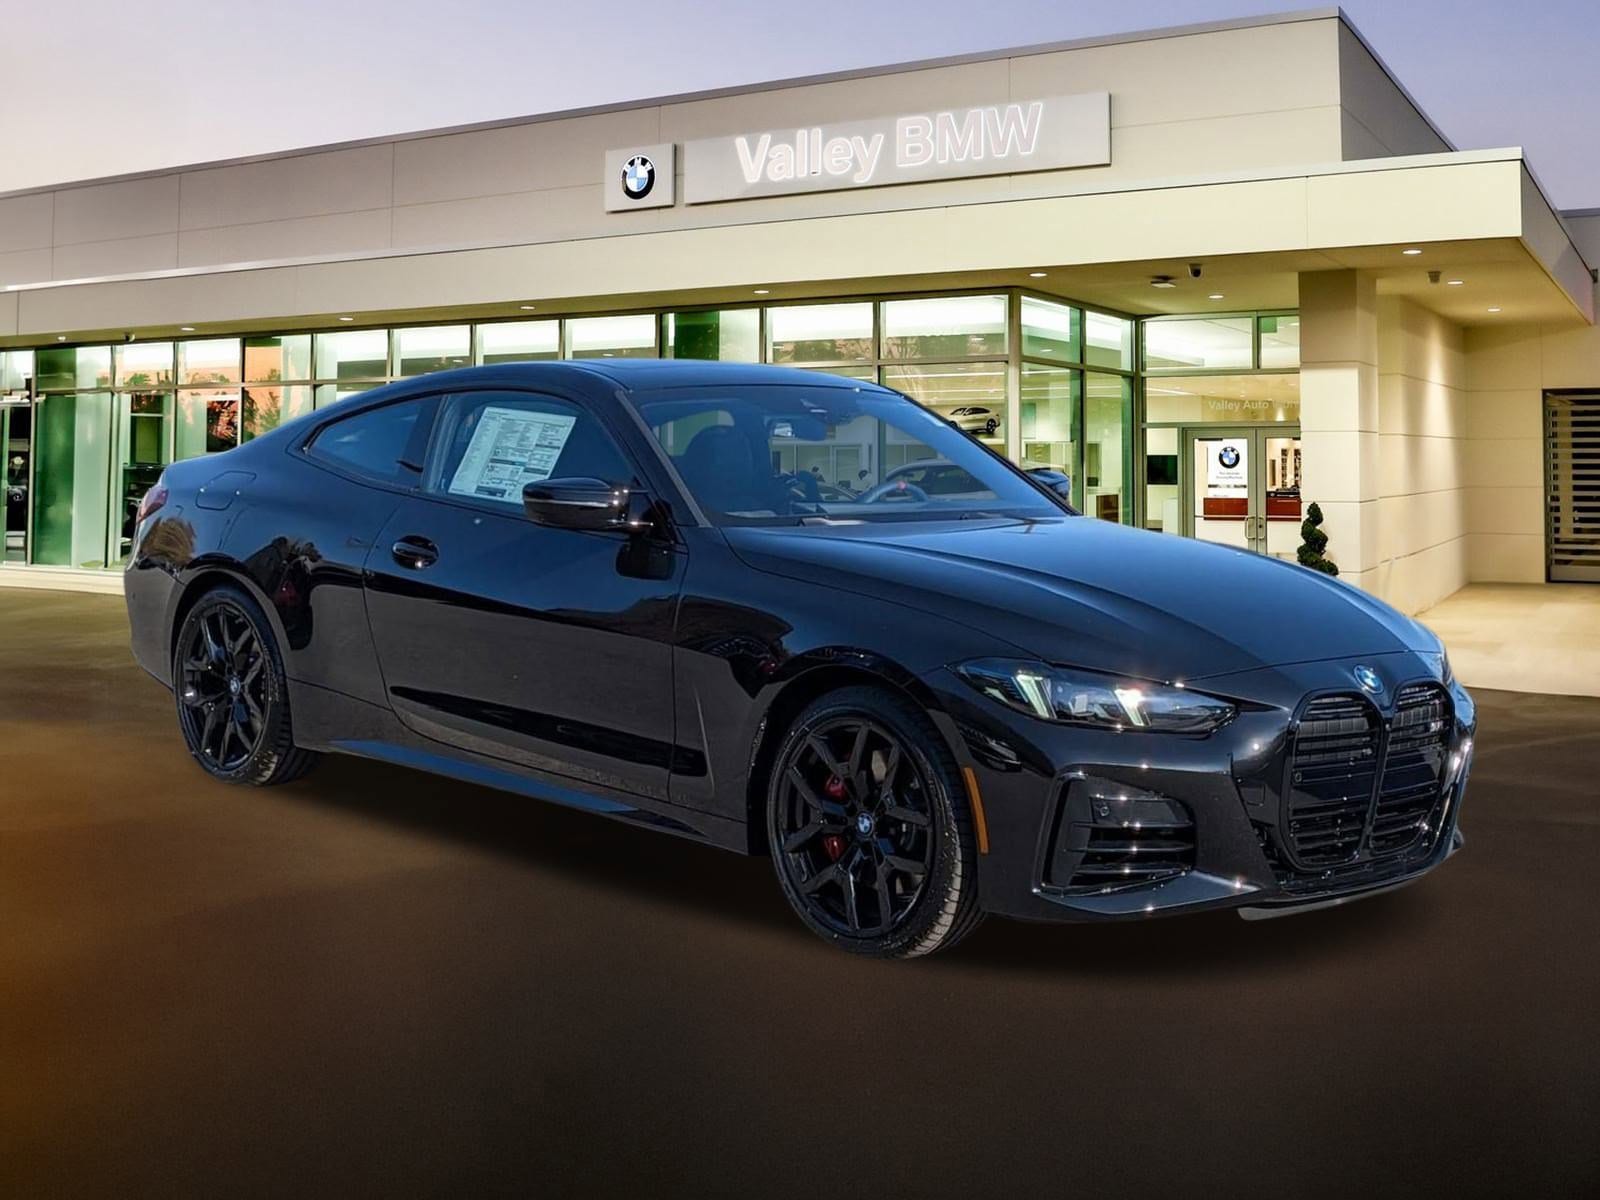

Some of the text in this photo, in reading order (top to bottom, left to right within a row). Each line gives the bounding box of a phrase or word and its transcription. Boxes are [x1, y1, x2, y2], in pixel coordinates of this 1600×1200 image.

[735, 102, 1043, 184] Valley BMW
[1208, 400, 1240, 412] Valley
[1243, 400, 1269, 409] Auto
